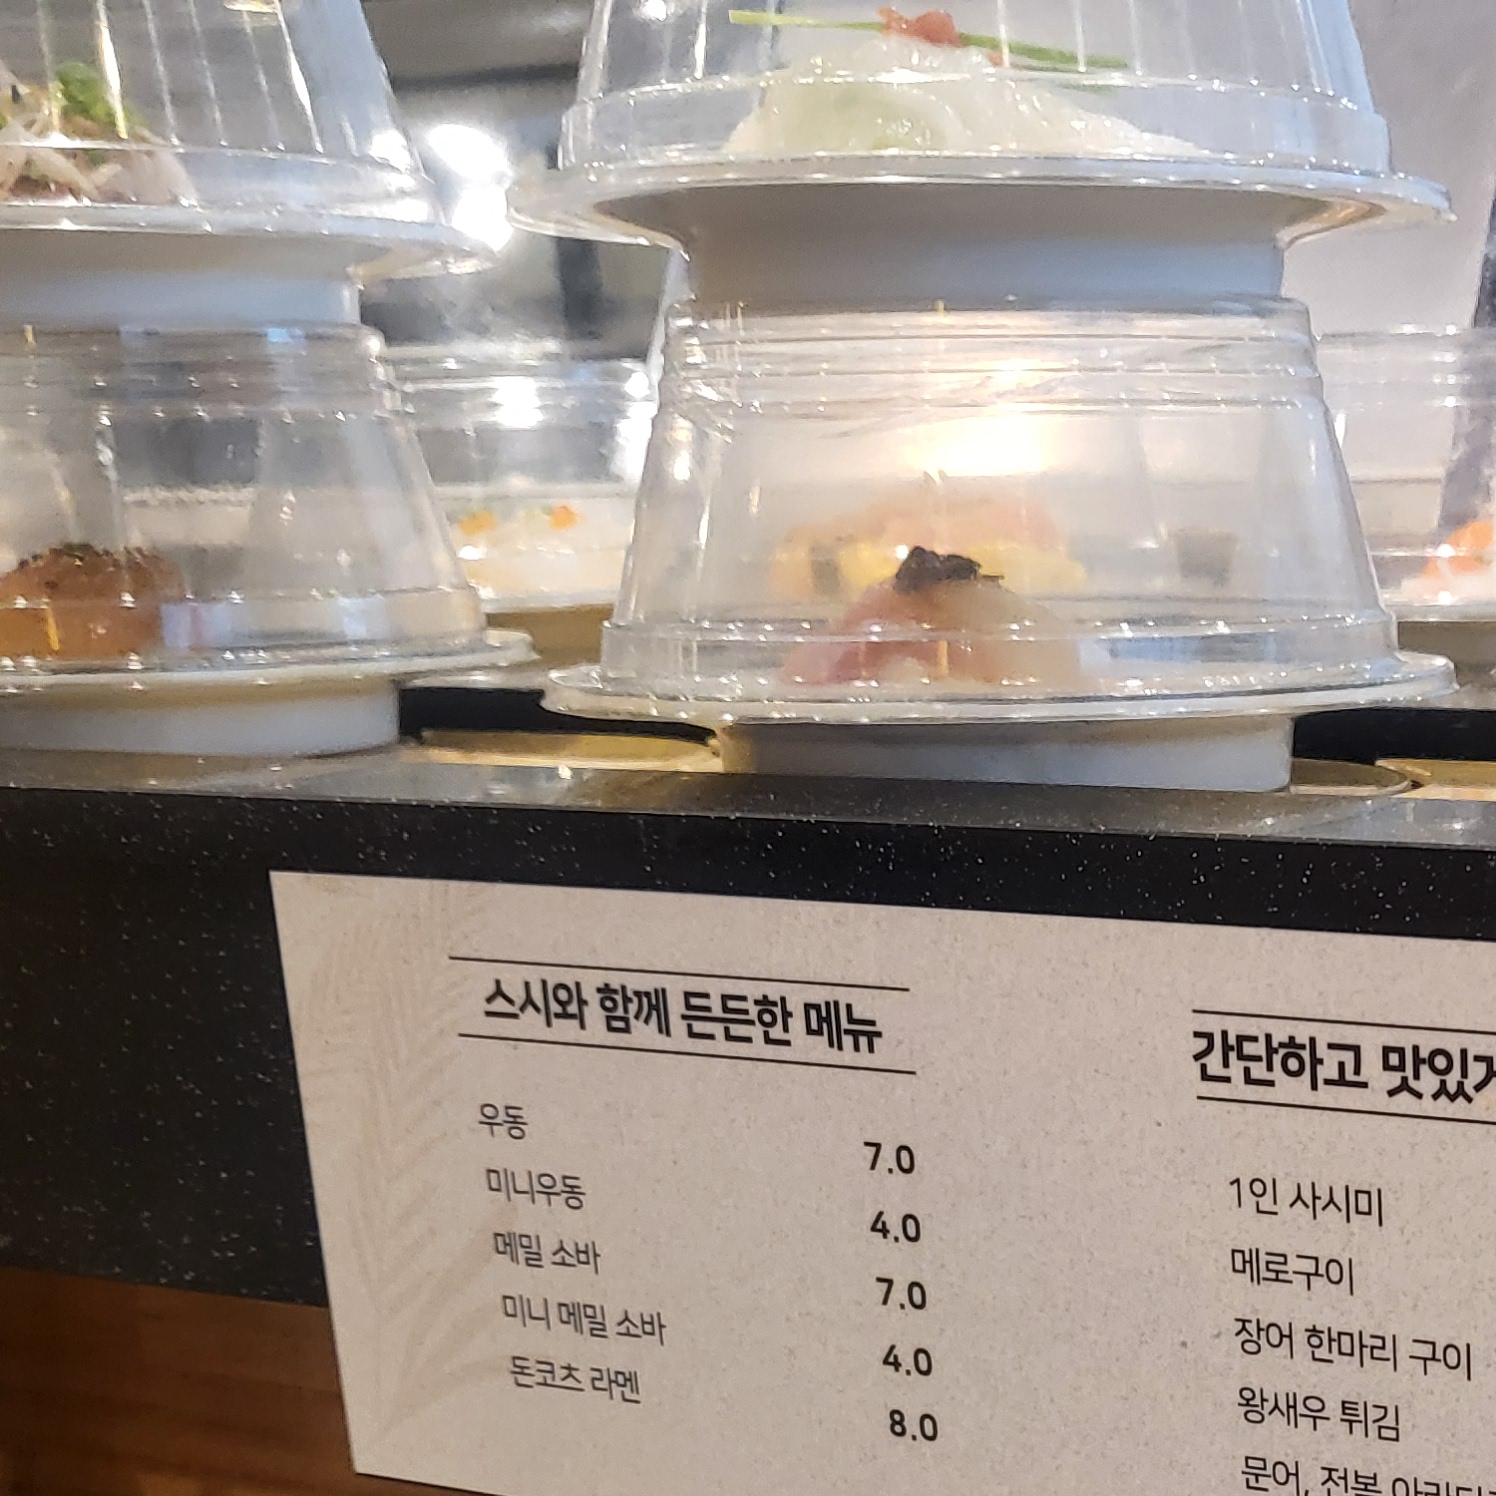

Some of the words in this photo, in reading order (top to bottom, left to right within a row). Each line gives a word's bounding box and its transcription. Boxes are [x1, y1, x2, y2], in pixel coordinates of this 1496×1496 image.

[483, 977, 590, 1032] 스시와
[594, 981, 673, 1039] 함께
[679, 989, 794, 1048] 든든한
[802, 998, 884, 1055] 메뉴
[1191, 1028, 1370, 1093] 간단하고
[478, 1102, 529, 1141] 우동
[862, 1140, 916, 1176] 7.0
[485, 1167, 586, 1211] 미니우동
[1228, 1176, 1279, 1217] 1인
[1288, 1180, 1384, 1228] 사시미
[869, 1209, 922, 1244] 4.0
[492, 1231, 544, 1269] 메밀
[551, 1239, 601, 1275] 소바
[1230, 1247, 1355, 1297] 메로구이
[874, 1275, 928, 1311] 7.0
[501, 1294, 551, 1331] 미니
[556, 1301, 609, 1340] 메밀
[615, 1309, 667, 1346] 소바
[881, 1343, 934, 1378] 4.0
[1233, 1317, 1295, 1360] 장어
[1303, 1323, 1398, 1373] 한마리
[1408, 1338, 1472, 1382] 구이
[509, 1355, 585, 1393] 돈코츠
[589, 1366, 642, 1405] 라멘
[888, 1408, 939, 1443] 8.0
[1237, 1385, 1331, 1432] 왕새우
[1339, 1399, 1401, 1443] 튀김
